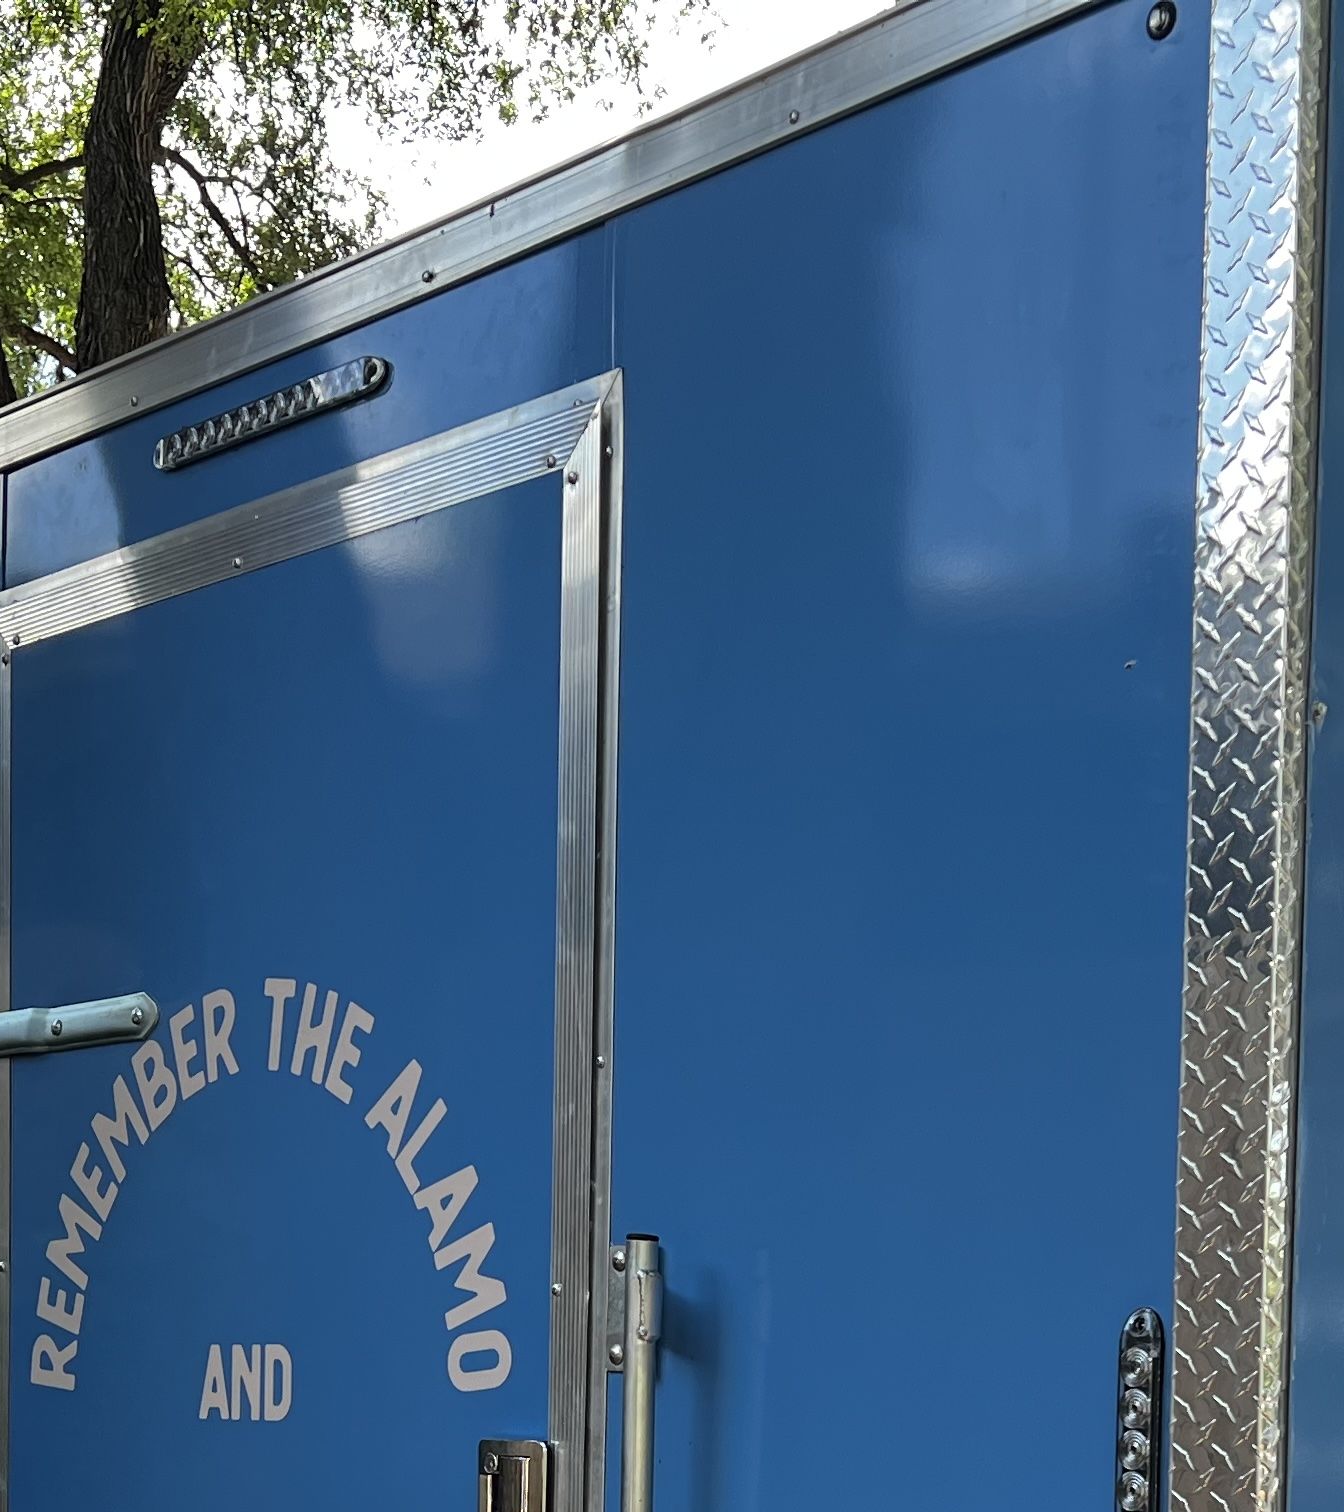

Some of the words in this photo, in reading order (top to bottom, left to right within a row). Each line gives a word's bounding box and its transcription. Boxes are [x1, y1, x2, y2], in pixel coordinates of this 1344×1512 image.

[31, 988, 240, 1391] REMEMBER
[263, 977, 375, 1105] THE
[364, 1058, 513, 1393] ALAMO
[198, 1343, 293, 1422] AND
